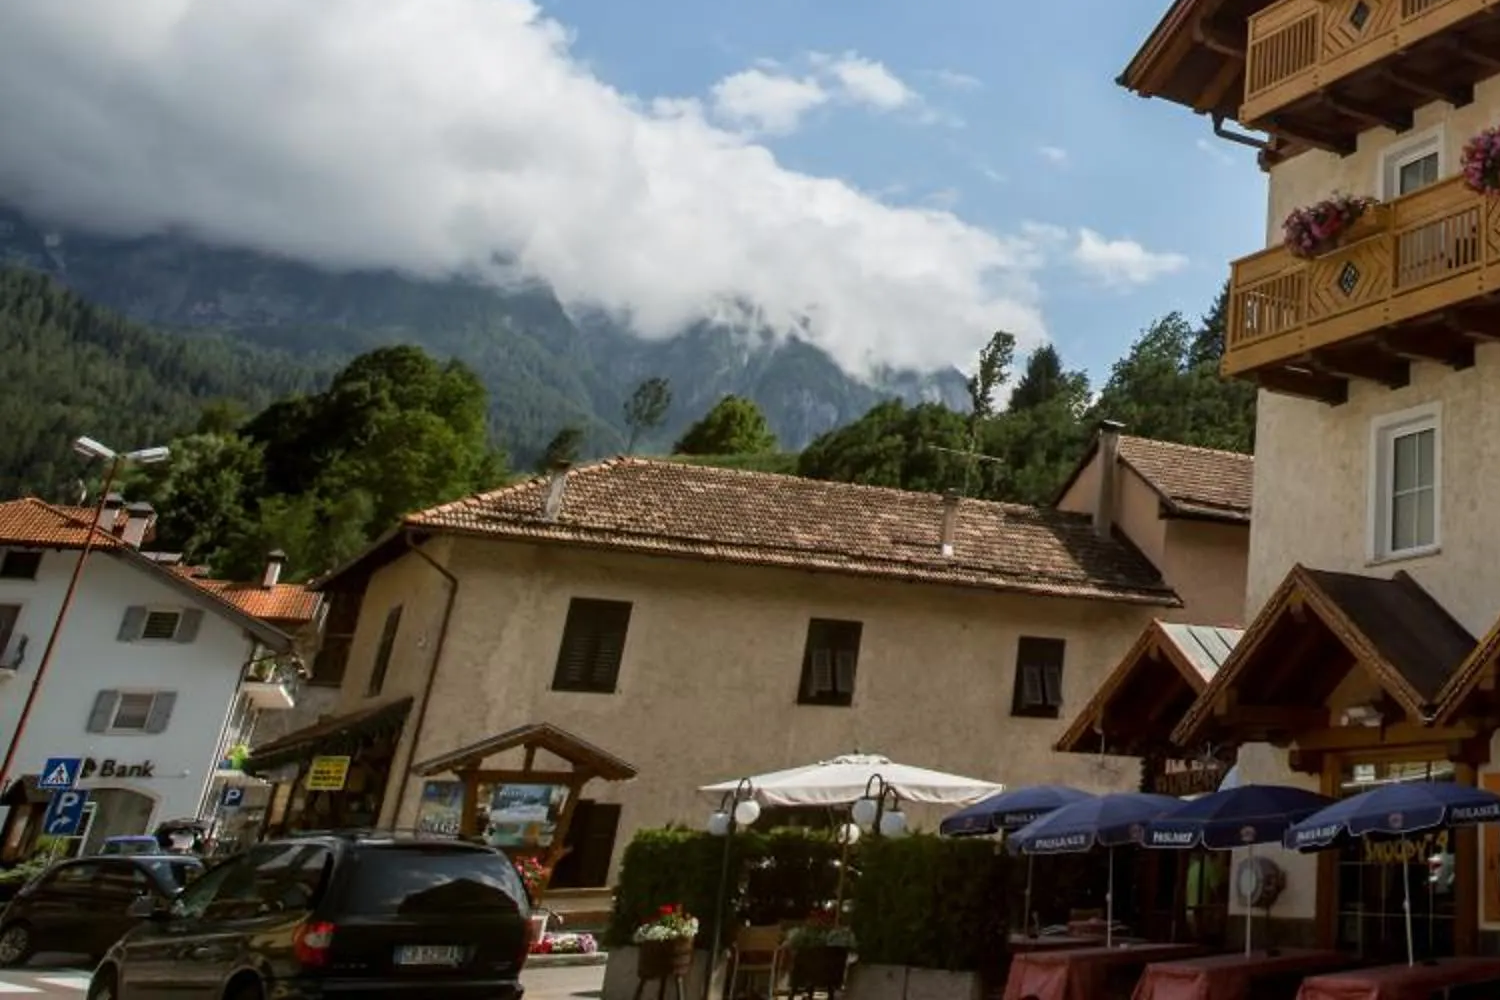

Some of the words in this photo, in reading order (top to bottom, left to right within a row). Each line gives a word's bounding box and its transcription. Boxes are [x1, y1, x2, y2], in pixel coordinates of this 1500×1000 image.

[99, 758, 155, 778] Bank
[55, 790, 77, 815] P
[224, 788, 241, 805] P
